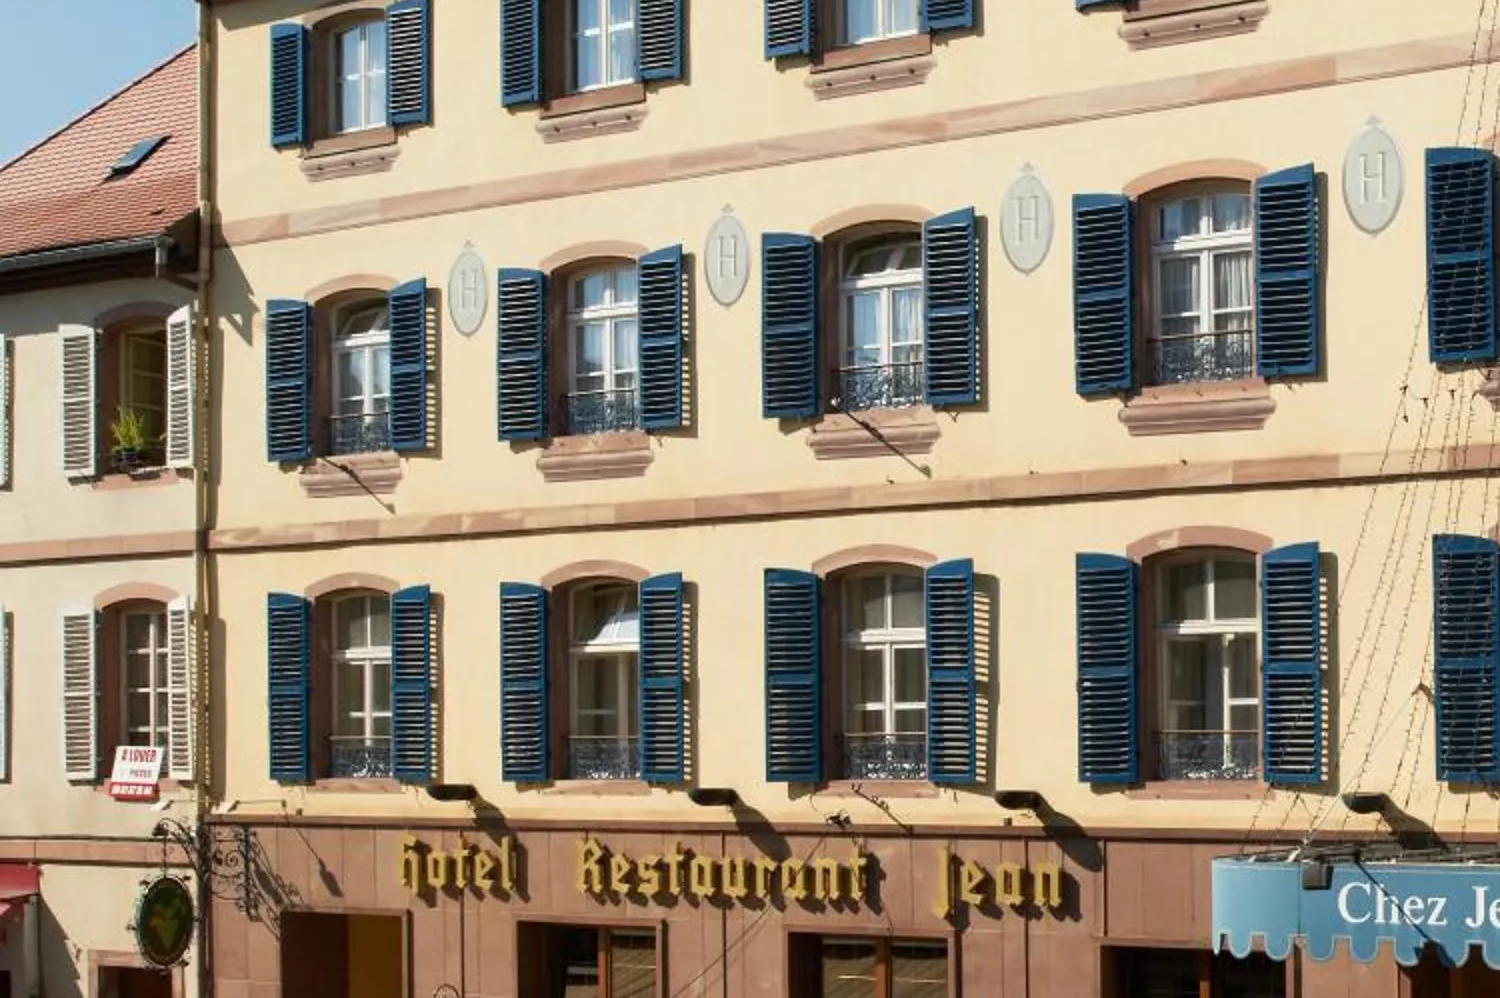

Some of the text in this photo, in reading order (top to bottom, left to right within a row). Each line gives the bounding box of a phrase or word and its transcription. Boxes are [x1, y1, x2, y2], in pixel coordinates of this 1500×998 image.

[1357, 150, 1387, 205] H
[1014, 195, 1041, 245] H
[717, 234, 738, 279] H
[576, 837, 868, 900] Restaurant
[930, 846, 1062, 921] Jean
[1337, 881, 1447, 926] Chez
